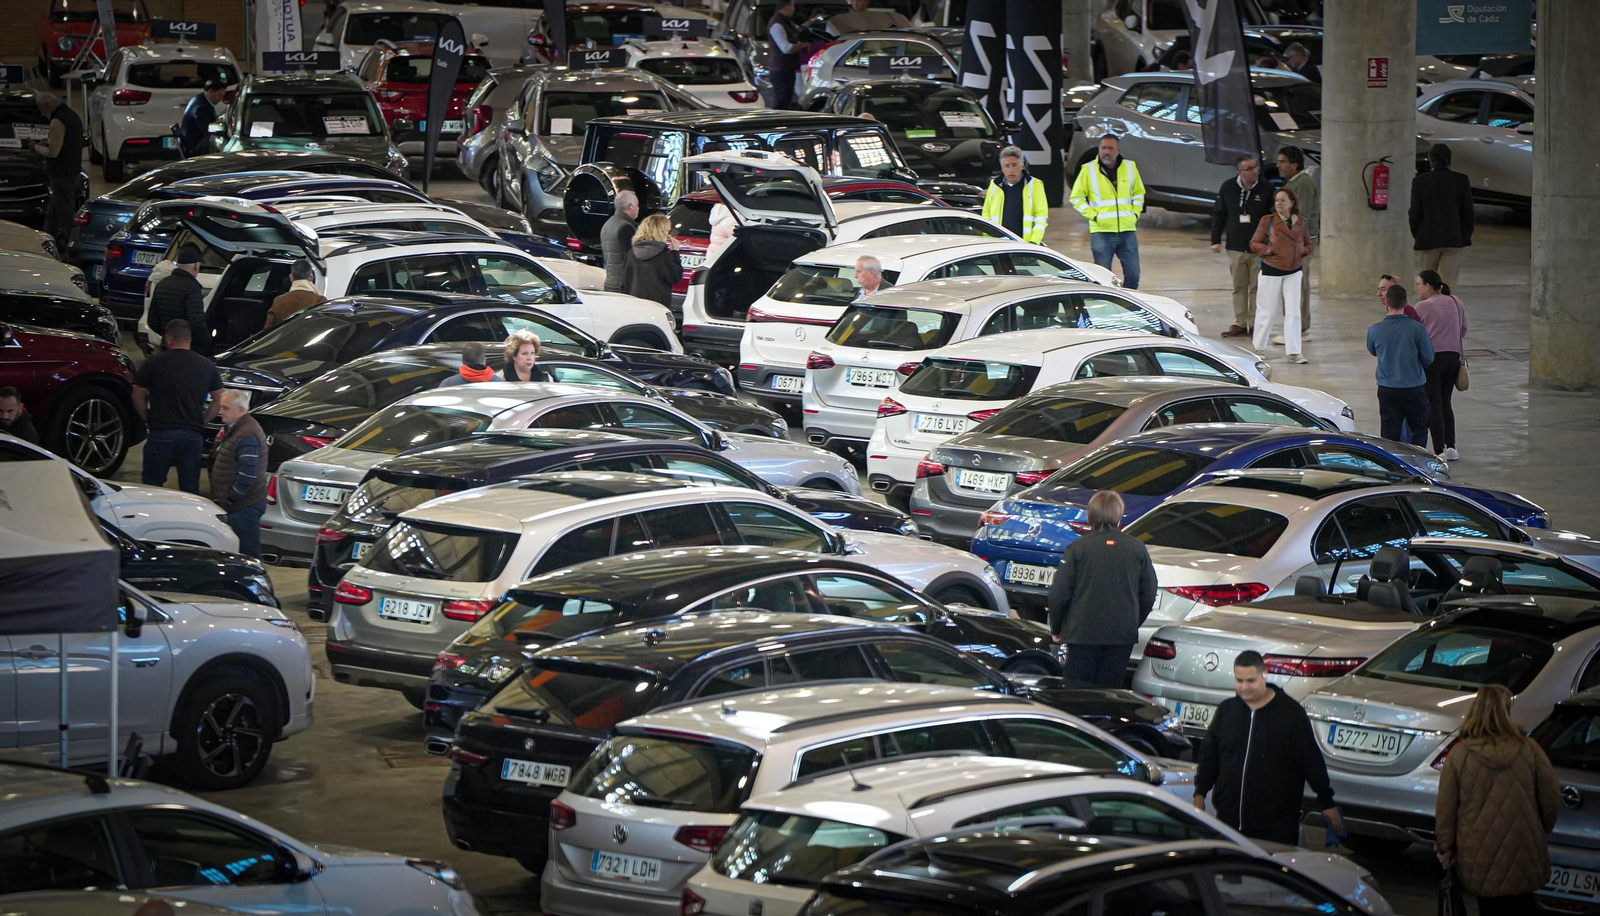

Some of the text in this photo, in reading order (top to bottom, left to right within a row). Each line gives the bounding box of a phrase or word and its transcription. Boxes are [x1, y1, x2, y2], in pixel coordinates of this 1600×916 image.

[1467, 4, 1507, 13] Diputación
[662, 19, 689, 28] KIA
[1467, 14, 1500, 23] de Cádiz
[169, 22, 198, 31] KIA
[439, 36, 464, 56] KIA
[285, 53, 318, 61] KIA
[585, 51, 610, 60] KIA
[890, 57, 922, 66] KIA
[136, 252, 155, 264] 0707
[777, 376, 798, 389] 0671
[850, 370, 873, 382] 7965
[920, 417, 964, 431] 7716 LVS
[963, 472, 985, 486] 1469
[307, 487, 330, 501] 9264
[1012, 566, 1053, 583] 8936 MY
[384, 600, 408, 616] 8218
[1183, 706, 1209, 722] 1380
[1336, 729, 1396, 751] 5777 JYD
[509, 762, 540, 780] 7848
[597, 854, 657, 878] 7321 LDH
[1549, 869, 1570, 886] 20
